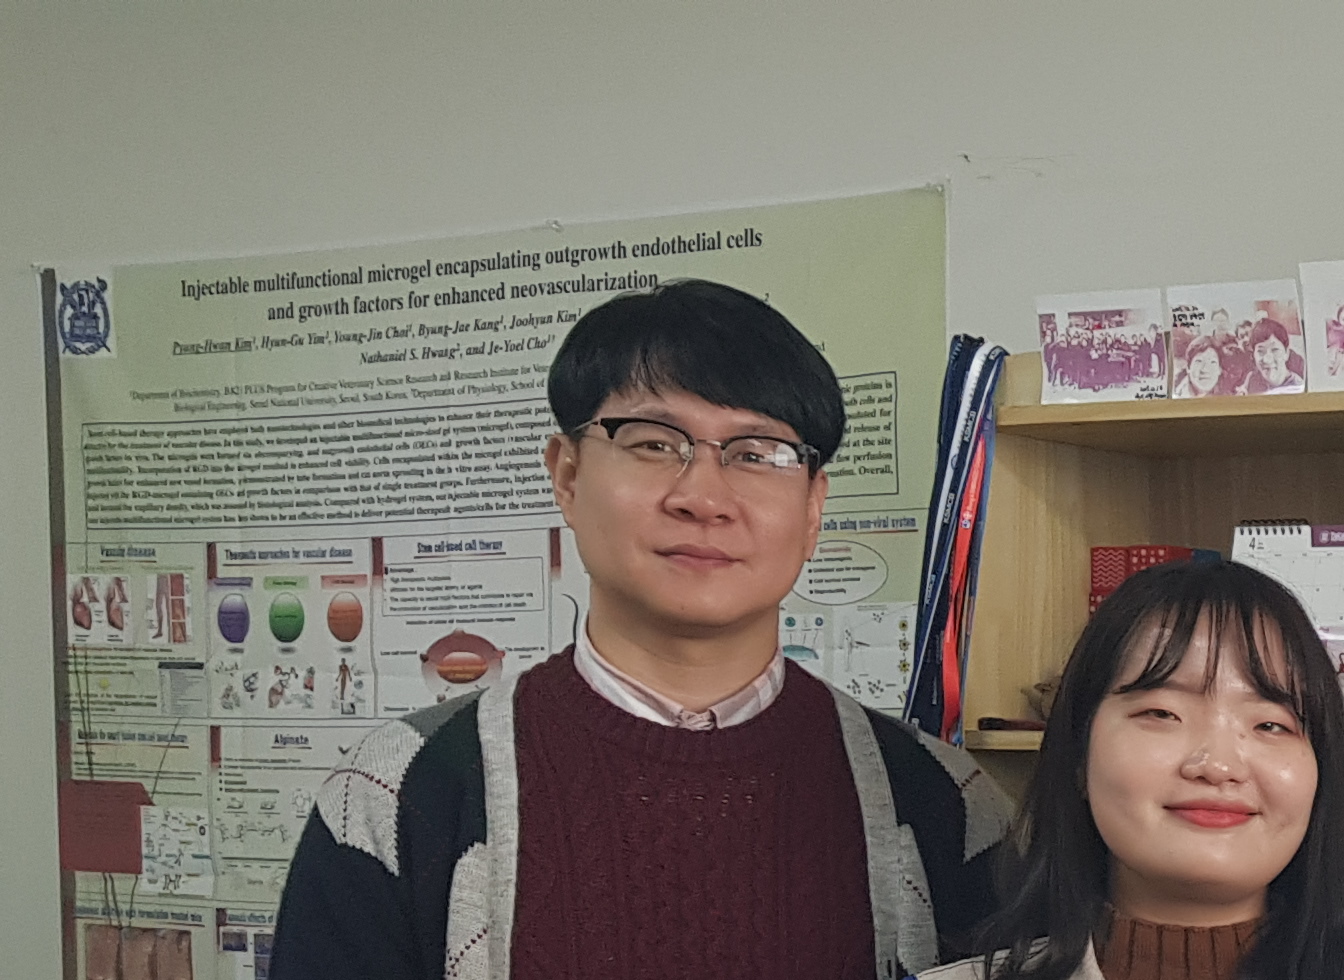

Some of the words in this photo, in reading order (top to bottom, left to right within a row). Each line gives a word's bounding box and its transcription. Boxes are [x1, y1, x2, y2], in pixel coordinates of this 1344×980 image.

[181, 276, 249, 300] Injectable
[254, 266, 362, 292] multifunctional
[367, 259, 432, 284] microgel
[436, 250, 541, 277] encapsulating
[545, 240, 627, 268] outgrowth
[632, 231, 721, 258] endothelial
[726, 228, 763, 248] cells
[268, 301, 294, 320] and
[298, 297, 350, 323] growth
[354, 294, 404, 315] factors
[408, 290, 429, 309] for
[434, 282, 505, 306] enhanced
[510, 270, 658, 299] neovascularization
